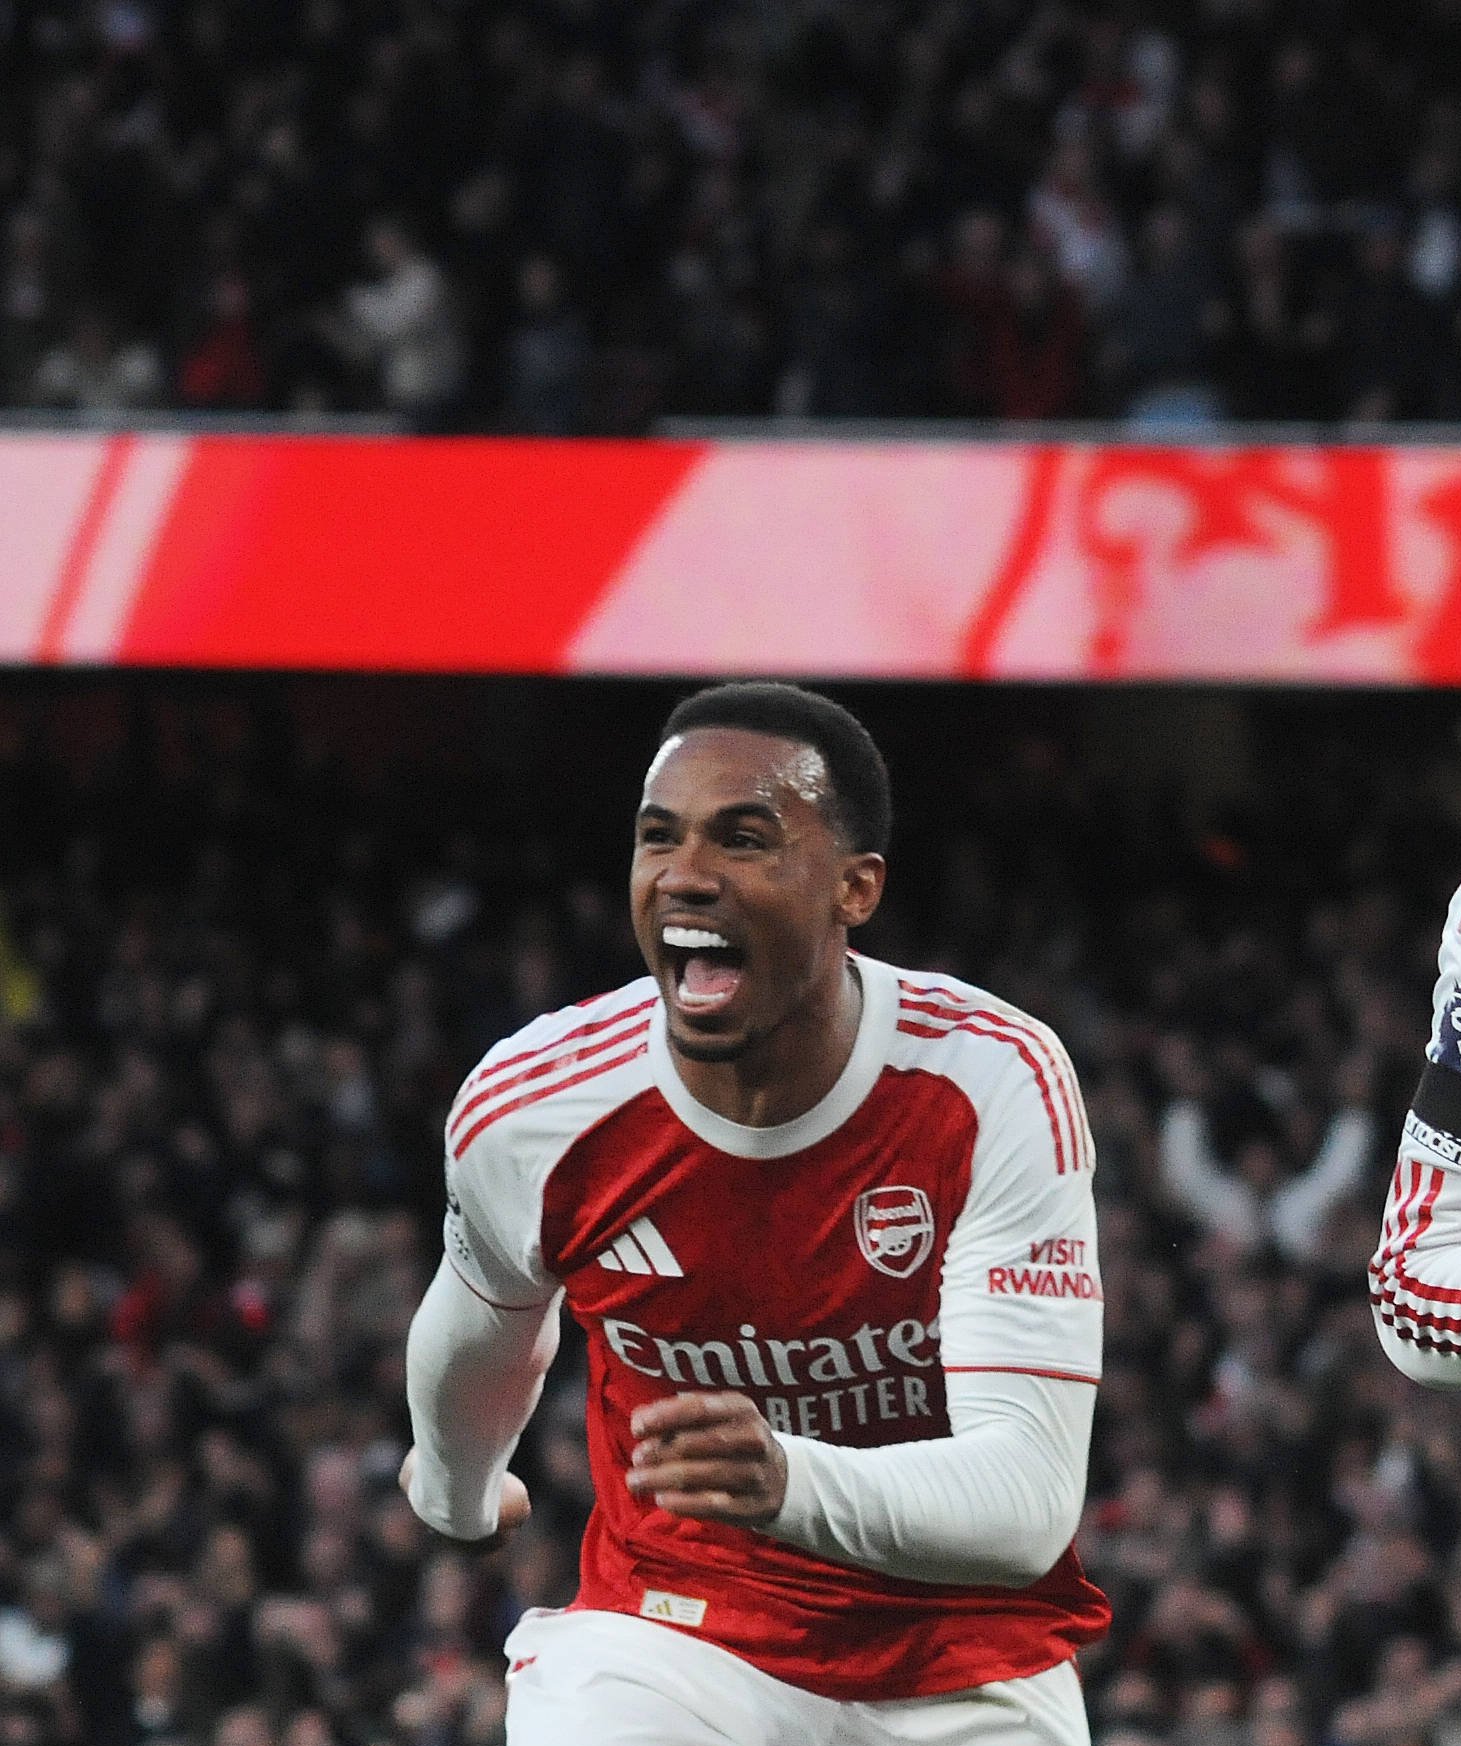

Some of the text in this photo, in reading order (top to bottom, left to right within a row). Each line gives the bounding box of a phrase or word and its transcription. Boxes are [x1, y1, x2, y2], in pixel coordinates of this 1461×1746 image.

[1030, 1238, 1086, 1267] VISIT
[988, 1267, 1103, 1299] RWAND
[766, 1376, 932, 1438] BETTER
